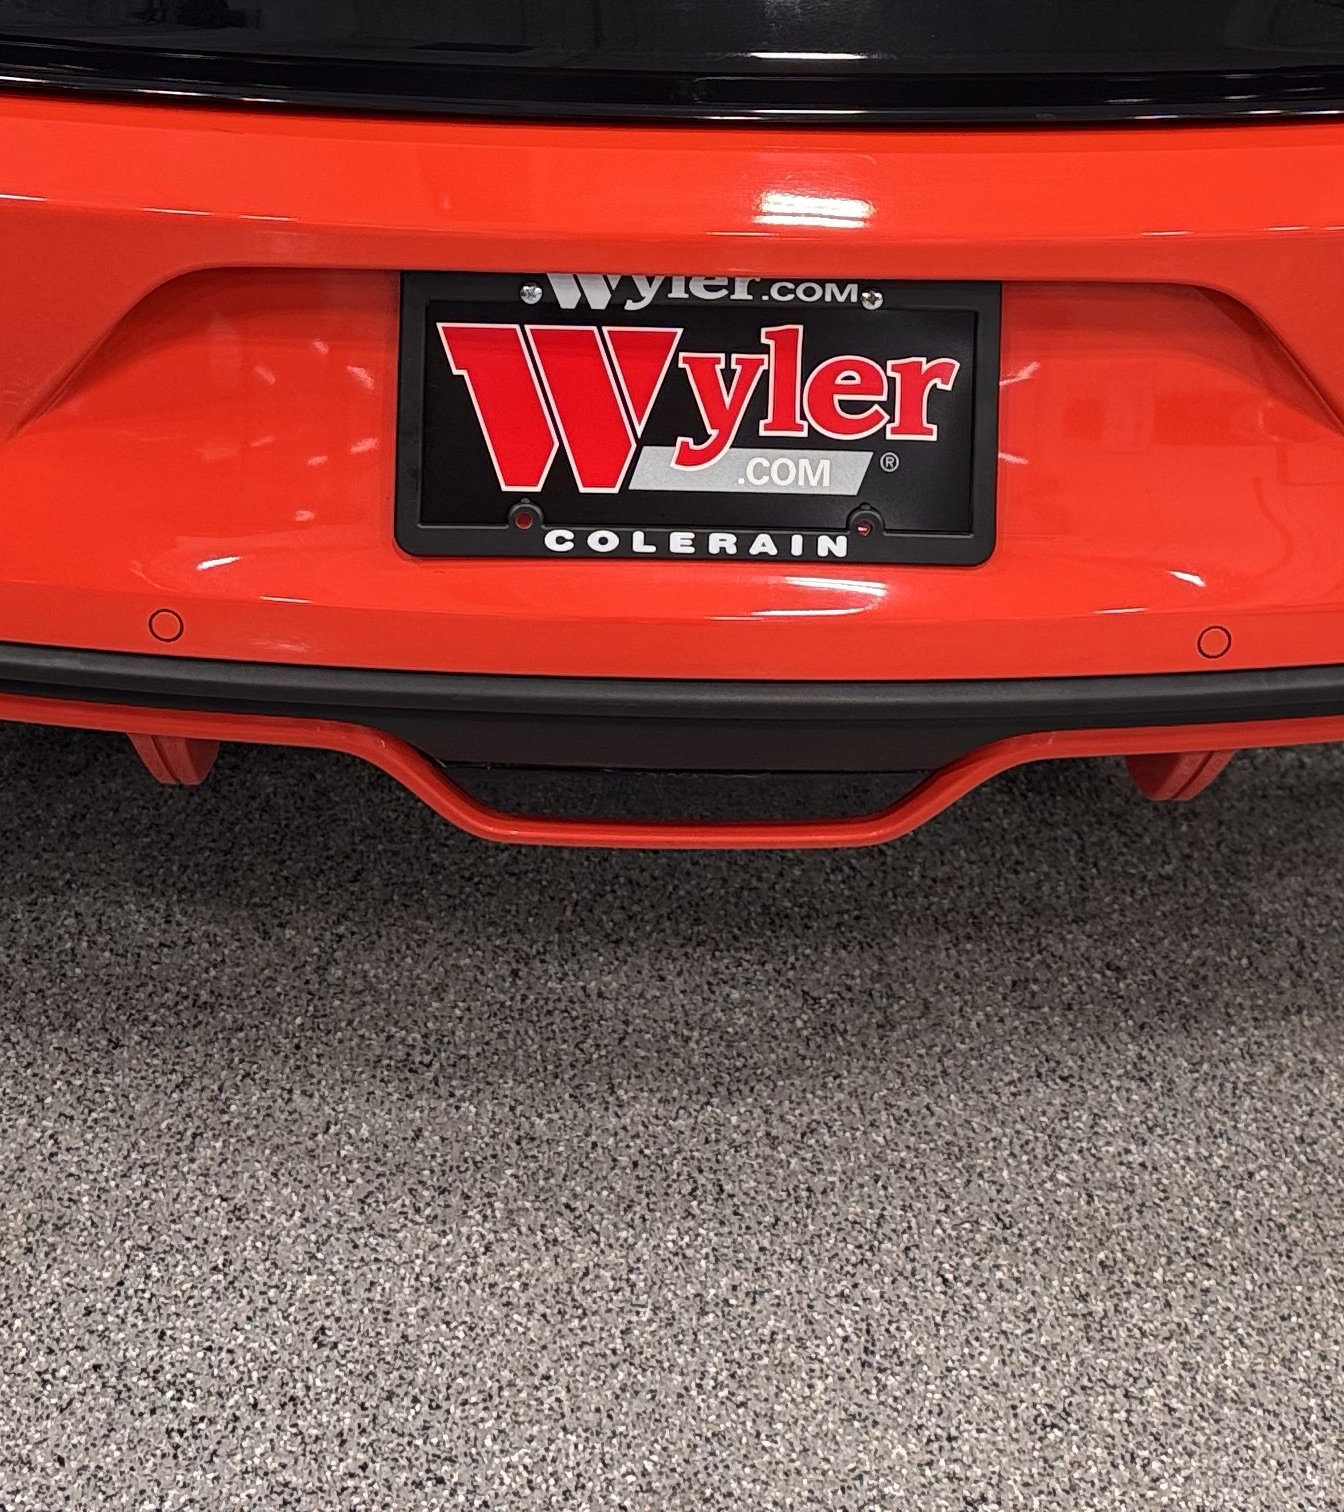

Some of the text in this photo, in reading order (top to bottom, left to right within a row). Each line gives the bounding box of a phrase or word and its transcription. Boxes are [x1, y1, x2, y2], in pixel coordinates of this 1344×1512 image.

[436, 322, 960, 493] Wyler
[737, 456, 832, 487] .COM
[543, 529, 848, 558] COLERAIN
